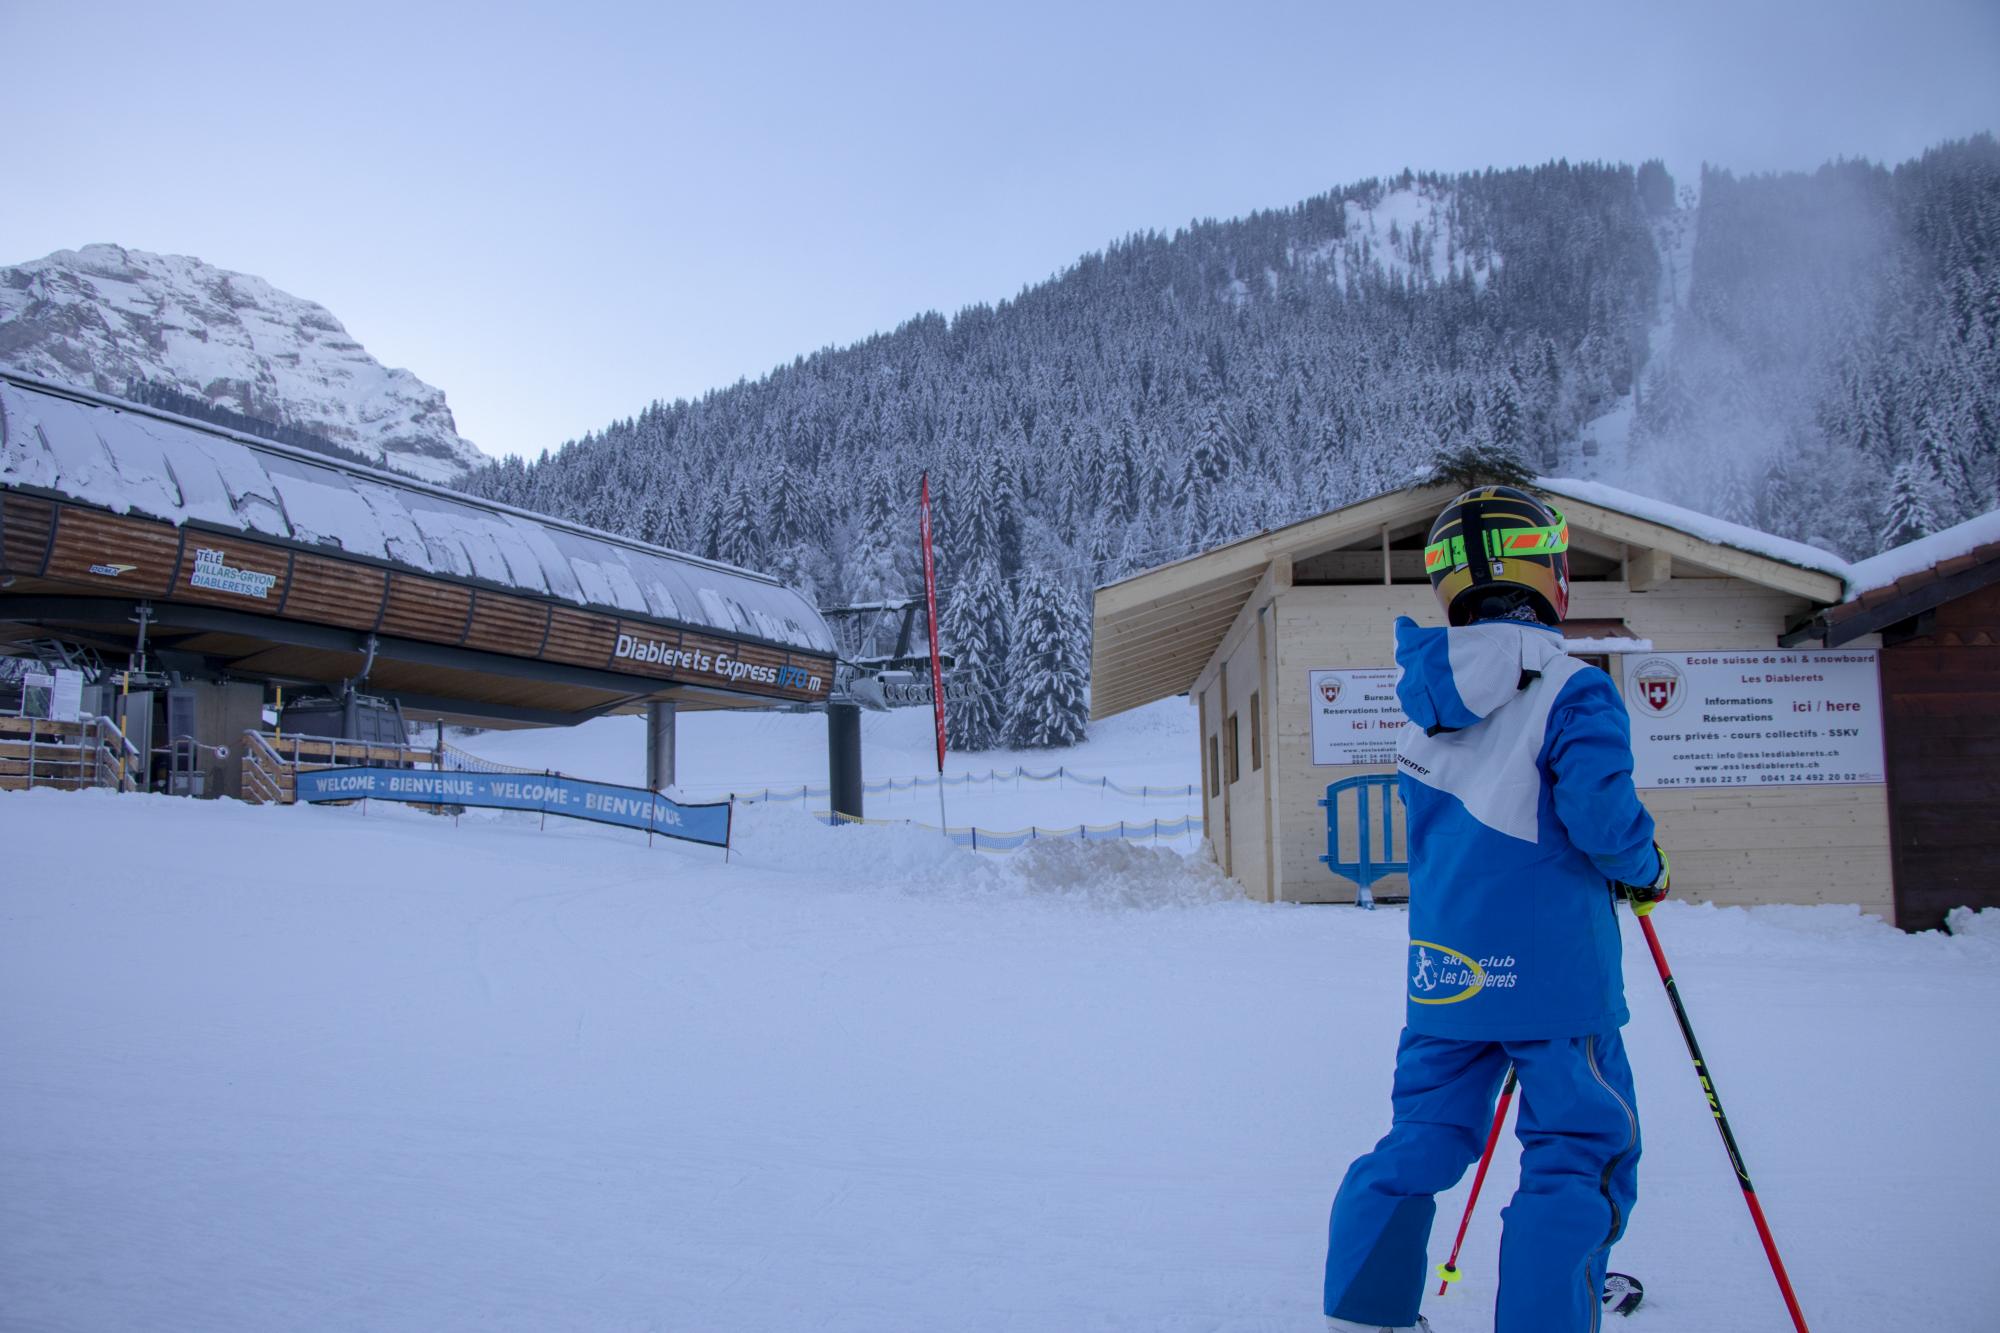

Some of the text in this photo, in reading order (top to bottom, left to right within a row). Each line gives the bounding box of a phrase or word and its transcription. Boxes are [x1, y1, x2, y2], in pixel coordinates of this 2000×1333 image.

[198, 550, 222, 564] TÉLÉ
[196, 563, 275, 587] VILLARS-GRYON
[192, 575, 267, 597] DIABLERETS SA
[615, 635, 711, 673] Diablerets
[714, 654, 777, 684] Express
[808, 676, 822, 692] m
[1686, 654, 1875, 665] Ecole suisse de ski & snowboard
[1741, 674, 1824, 683] Les Diablerets
[1705, 696, 1773, 706] Informations
[1793, 700, 1811, 712] ici
[1826, 700, 1861, 712] here
[1352, 720, 1367, 730] ici
[1379, 720, 1407, 730] here
[1650, 733, 1681, 741] cours
[1685, 732, 1720, 742] privés
[1730, 732, 1762, 740] cours
[1765, 730, 1818, 739] collectifs
[1829, 729, 1859, 737] SSKV
[316, 776, 376, 792] WELCOME
[389, 777, 474, 796] BIENVENUE
[490, 781, 568, 804] WELCOME
[585, 793, 684, 827] BIENVENUE
[1442, 955, 1463, 965] ski
[1478, 956, 1516, 967] club
[1440, 968, 1517, 988] Les Diablerets
